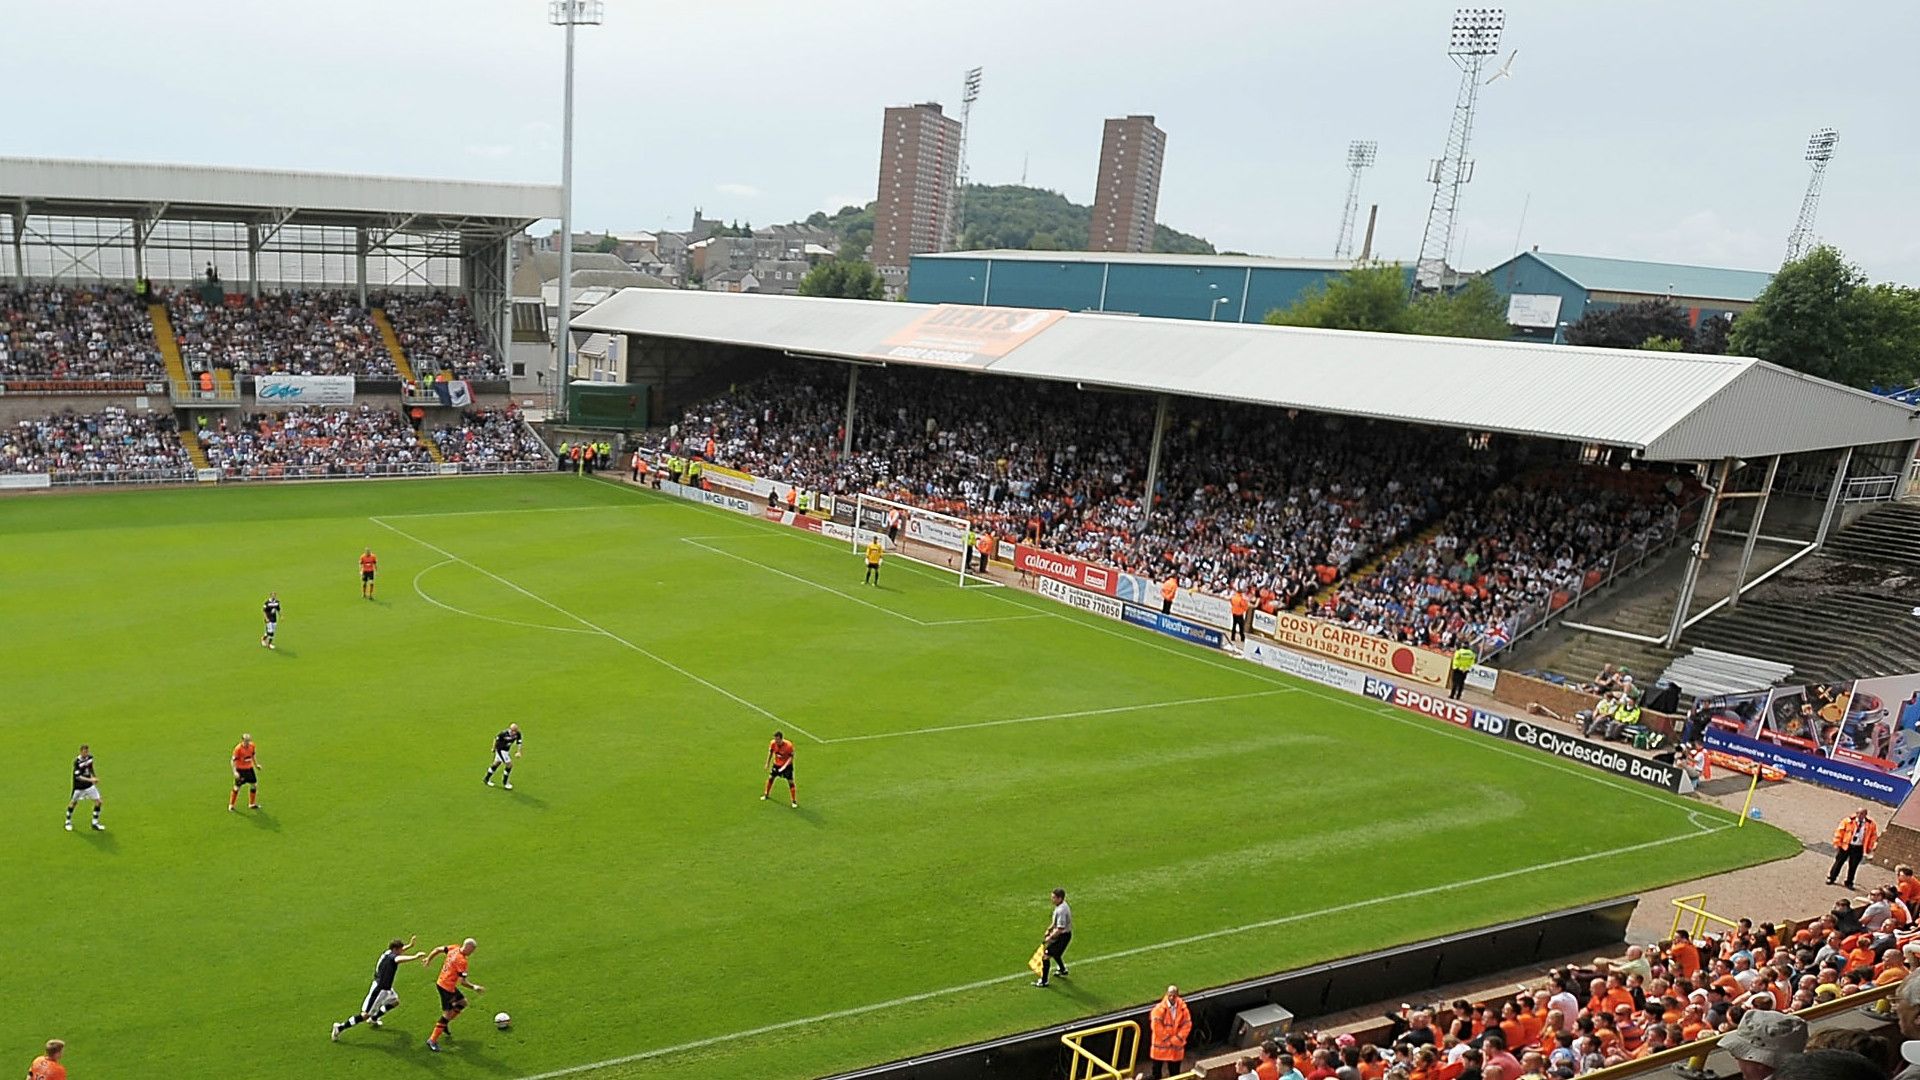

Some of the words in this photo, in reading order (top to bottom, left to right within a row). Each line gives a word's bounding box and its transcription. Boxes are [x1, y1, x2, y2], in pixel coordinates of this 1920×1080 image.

[1025, 554, 1077, 579] color.co.uk
[1069, 594, 1091, 608] 01382
[1093, 601, 1120, 617] 770050
[1279, 629, 1302, 644] TEL:
[1306, 638, 1340, 654] 01382
[1343, 647, 1387, 668] 811149
[1280, 616, 1318, 636] COSY
[1323, 627, 1389, 654] CARPETS
[1366, 679, 1393, 701] sky
[1395, 688, 1468, 724] SPORTS
[1474, 711, 1504, 734] HD
[1539, 732, 1627, 772] Clydesdale
[1630, 759, 1673, 786] Bank
[1728, 742, 1765, 758] Automotive
[1773, 754, 1807, 770] Electronic
[1816, 766, 1855, 782] Aerospace
[1863, 778, 1894, 793] Defence
